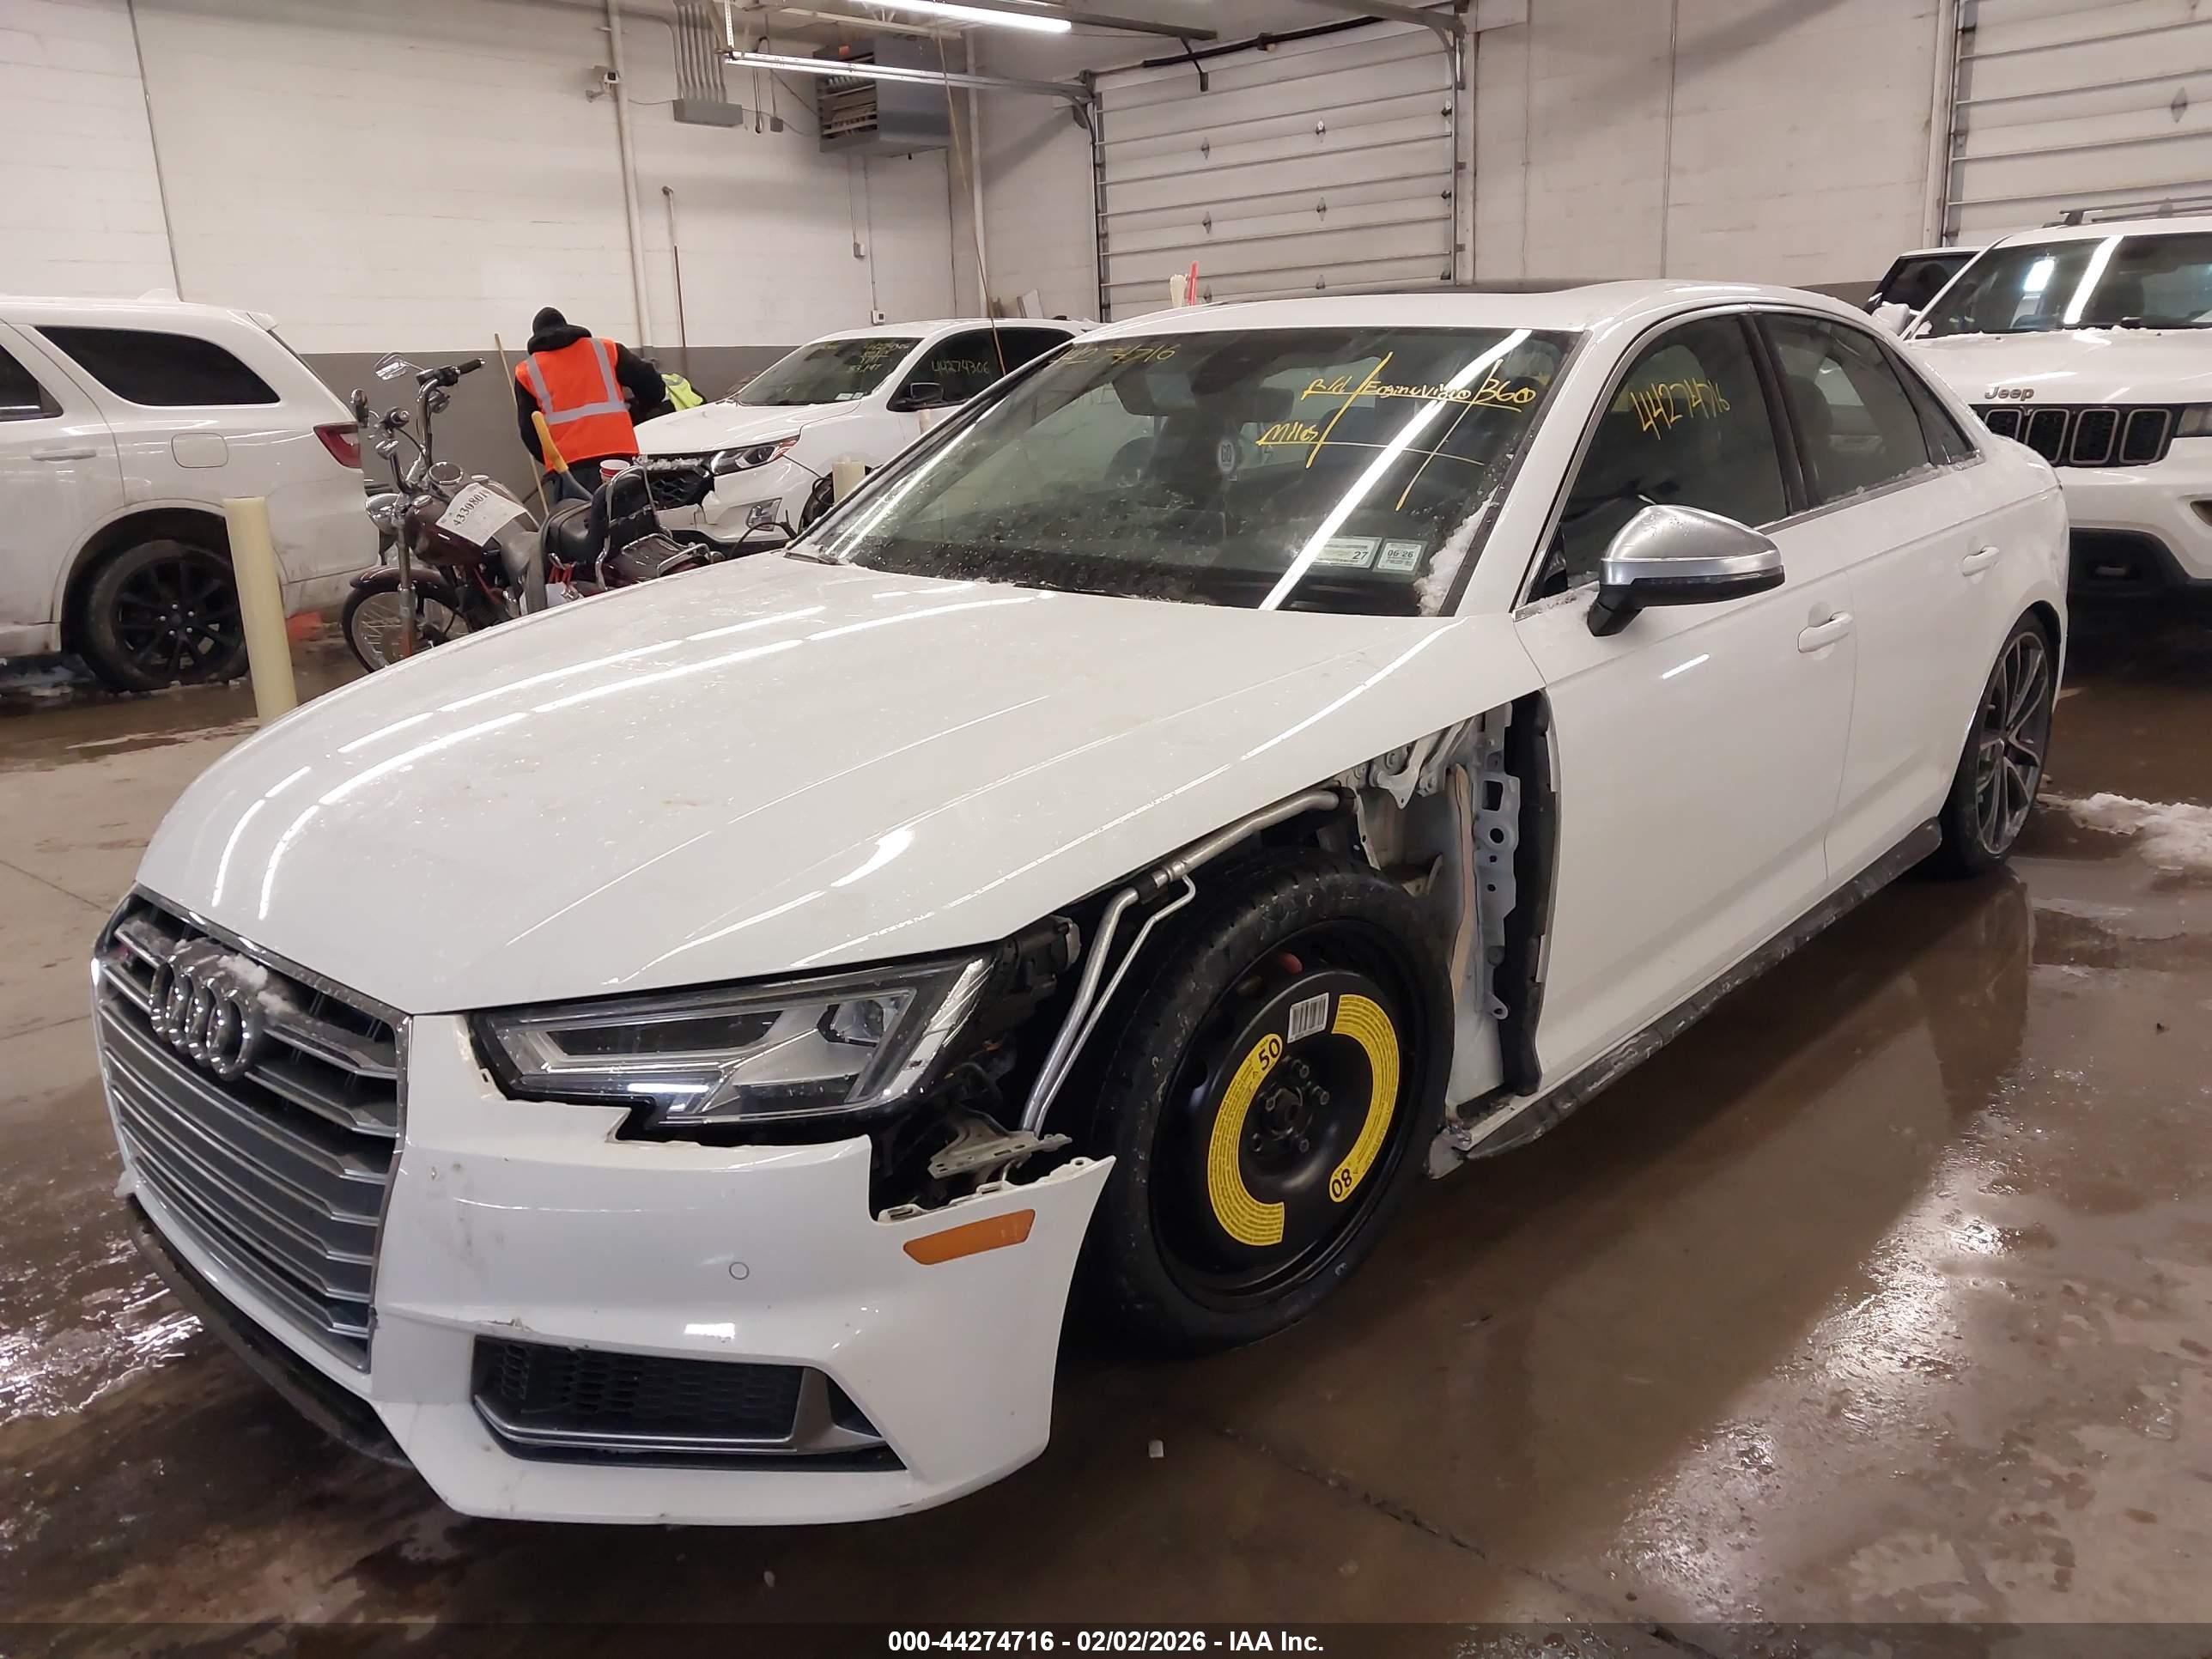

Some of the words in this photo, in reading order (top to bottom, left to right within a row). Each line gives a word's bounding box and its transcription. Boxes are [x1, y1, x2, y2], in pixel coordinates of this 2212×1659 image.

[932, 358, 990, 376] 44274306
[1984, 386, 2035, 402] Jeep
[1630, 377, 1730, 441] 44274716
[1352, 550, 1369, 561] 27
[1258, 1037, 1280, 1072] 50
